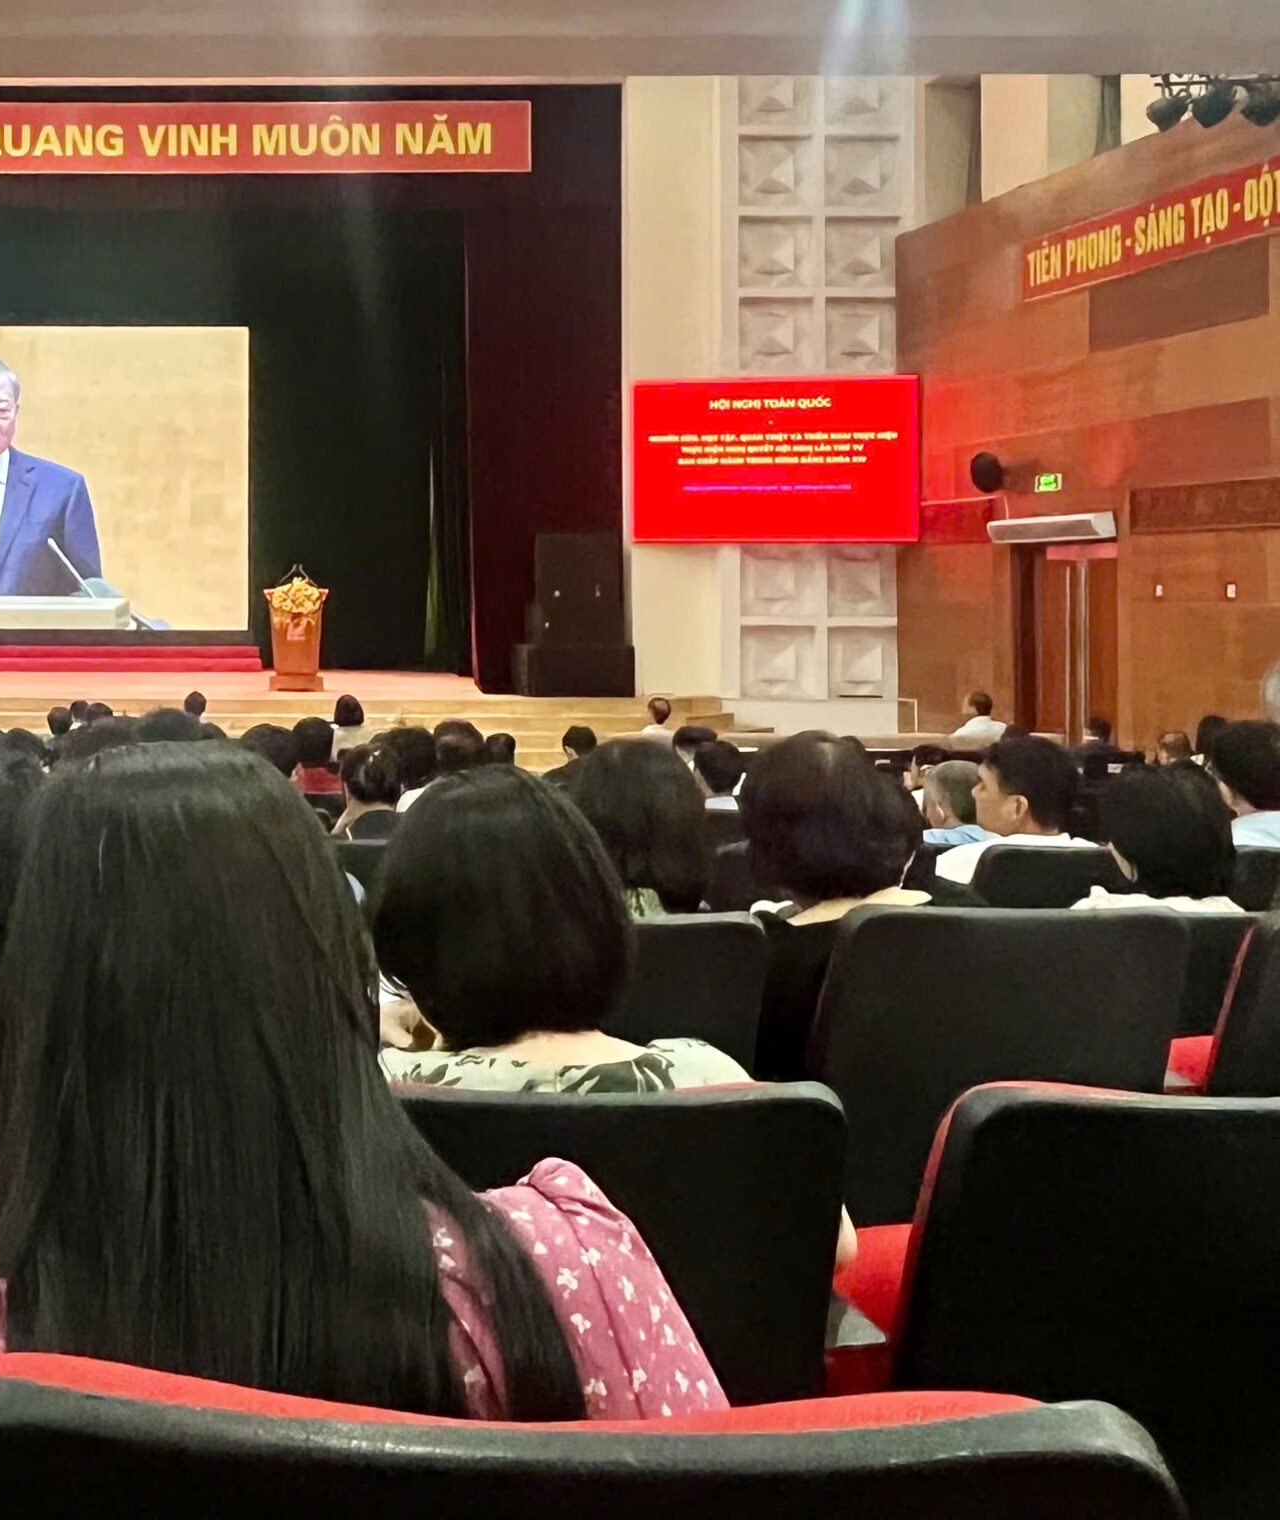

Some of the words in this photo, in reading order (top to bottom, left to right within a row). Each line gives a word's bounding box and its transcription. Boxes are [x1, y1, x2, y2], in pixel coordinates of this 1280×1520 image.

[138, 124, 238, 157] VINH
[252, 115, 381, 156] MUÔN
[395, 113, 493, 155] NĂM
[1066, 224, 1122, 277] PHONG
[1134, 203, 1186, 256] SÁNG
[1191, 188, 1229, 244] TẠO
[709, 398, 730, 411] HỘI
[763, 397, 795, 408] TOÀN
[797, 396, 832, 409] QUỐC
